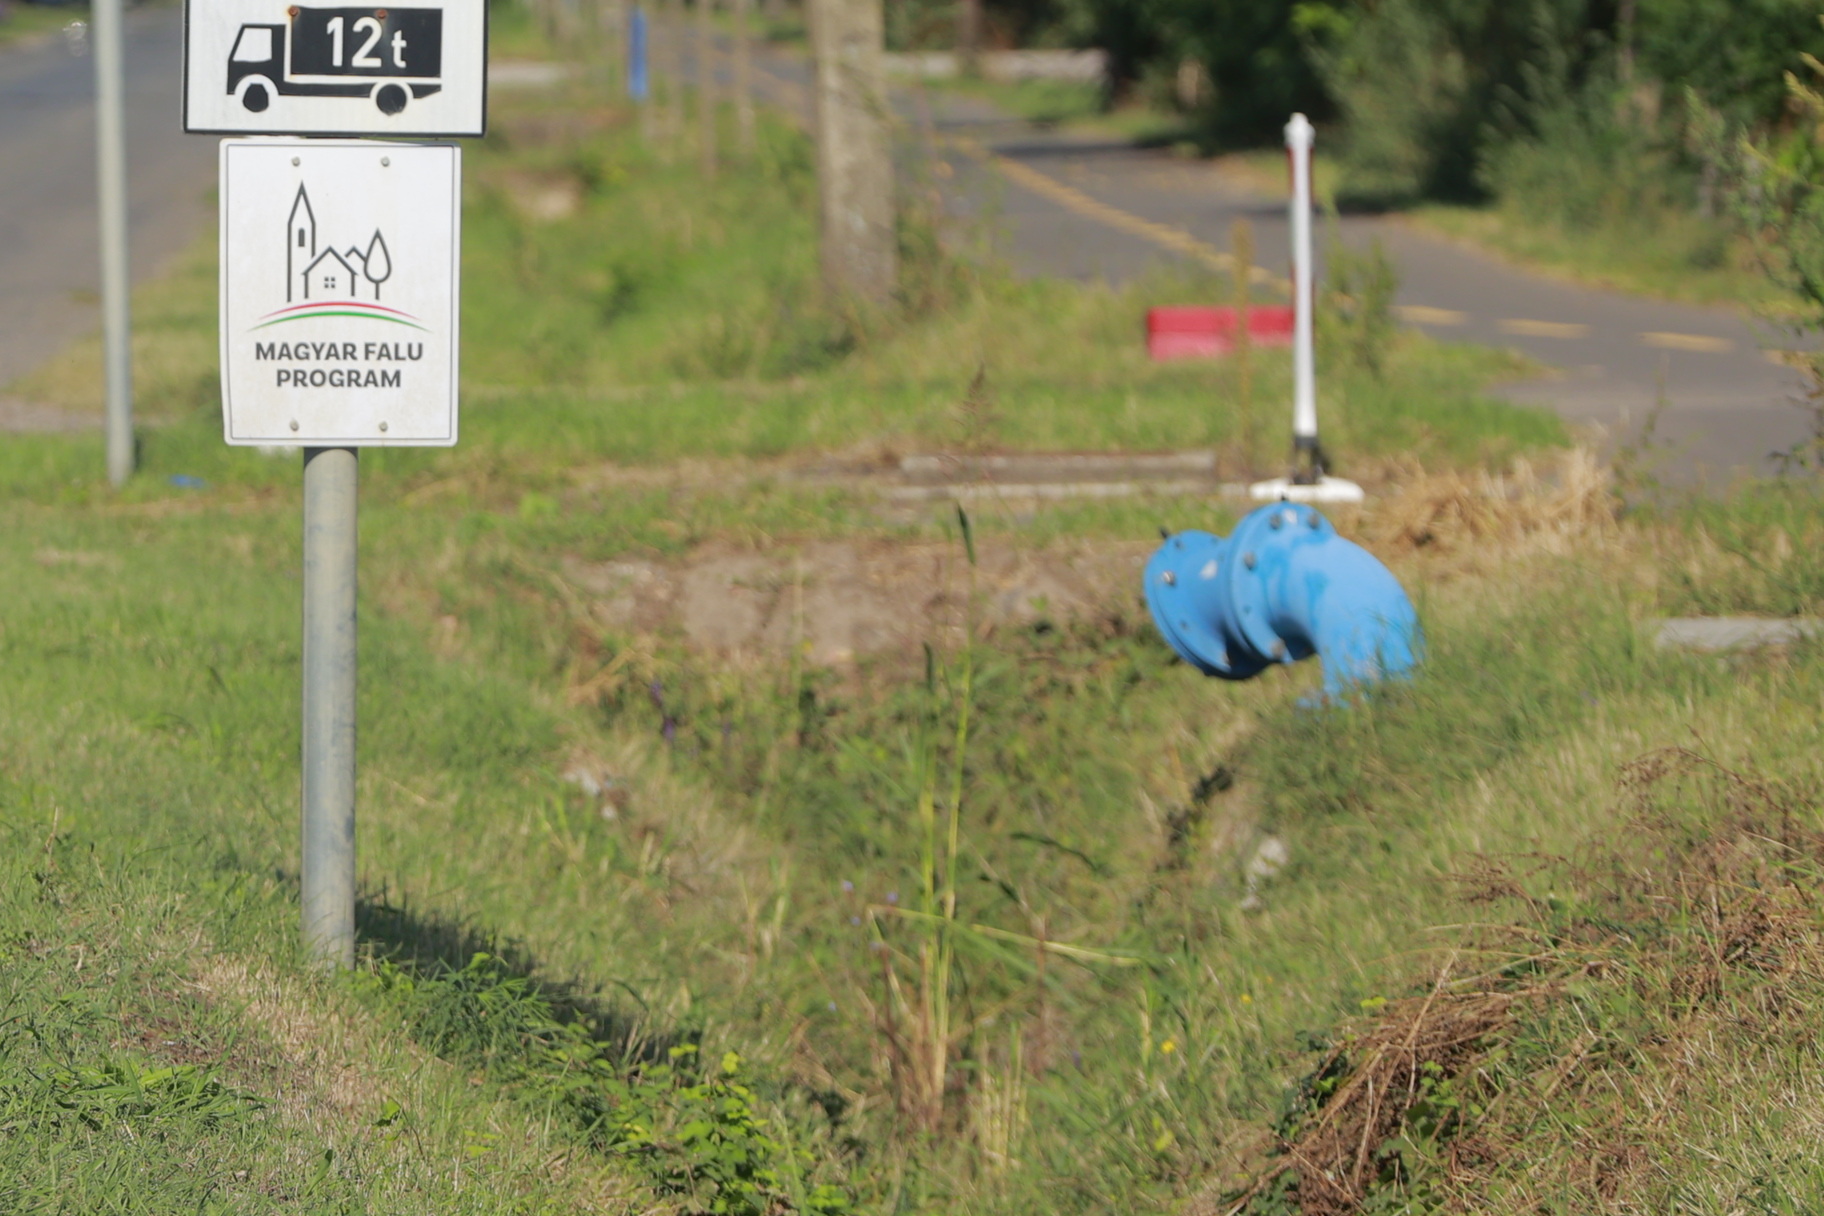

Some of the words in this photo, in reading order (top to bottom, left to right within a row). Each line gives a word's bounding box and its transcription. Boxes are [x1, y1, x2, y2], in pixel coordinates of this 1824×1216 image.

[255, 341, 358, 362] MAGYAR
[363, 341, 424, 362] FALU
[275, 368, 402, 388] PROGRAM
